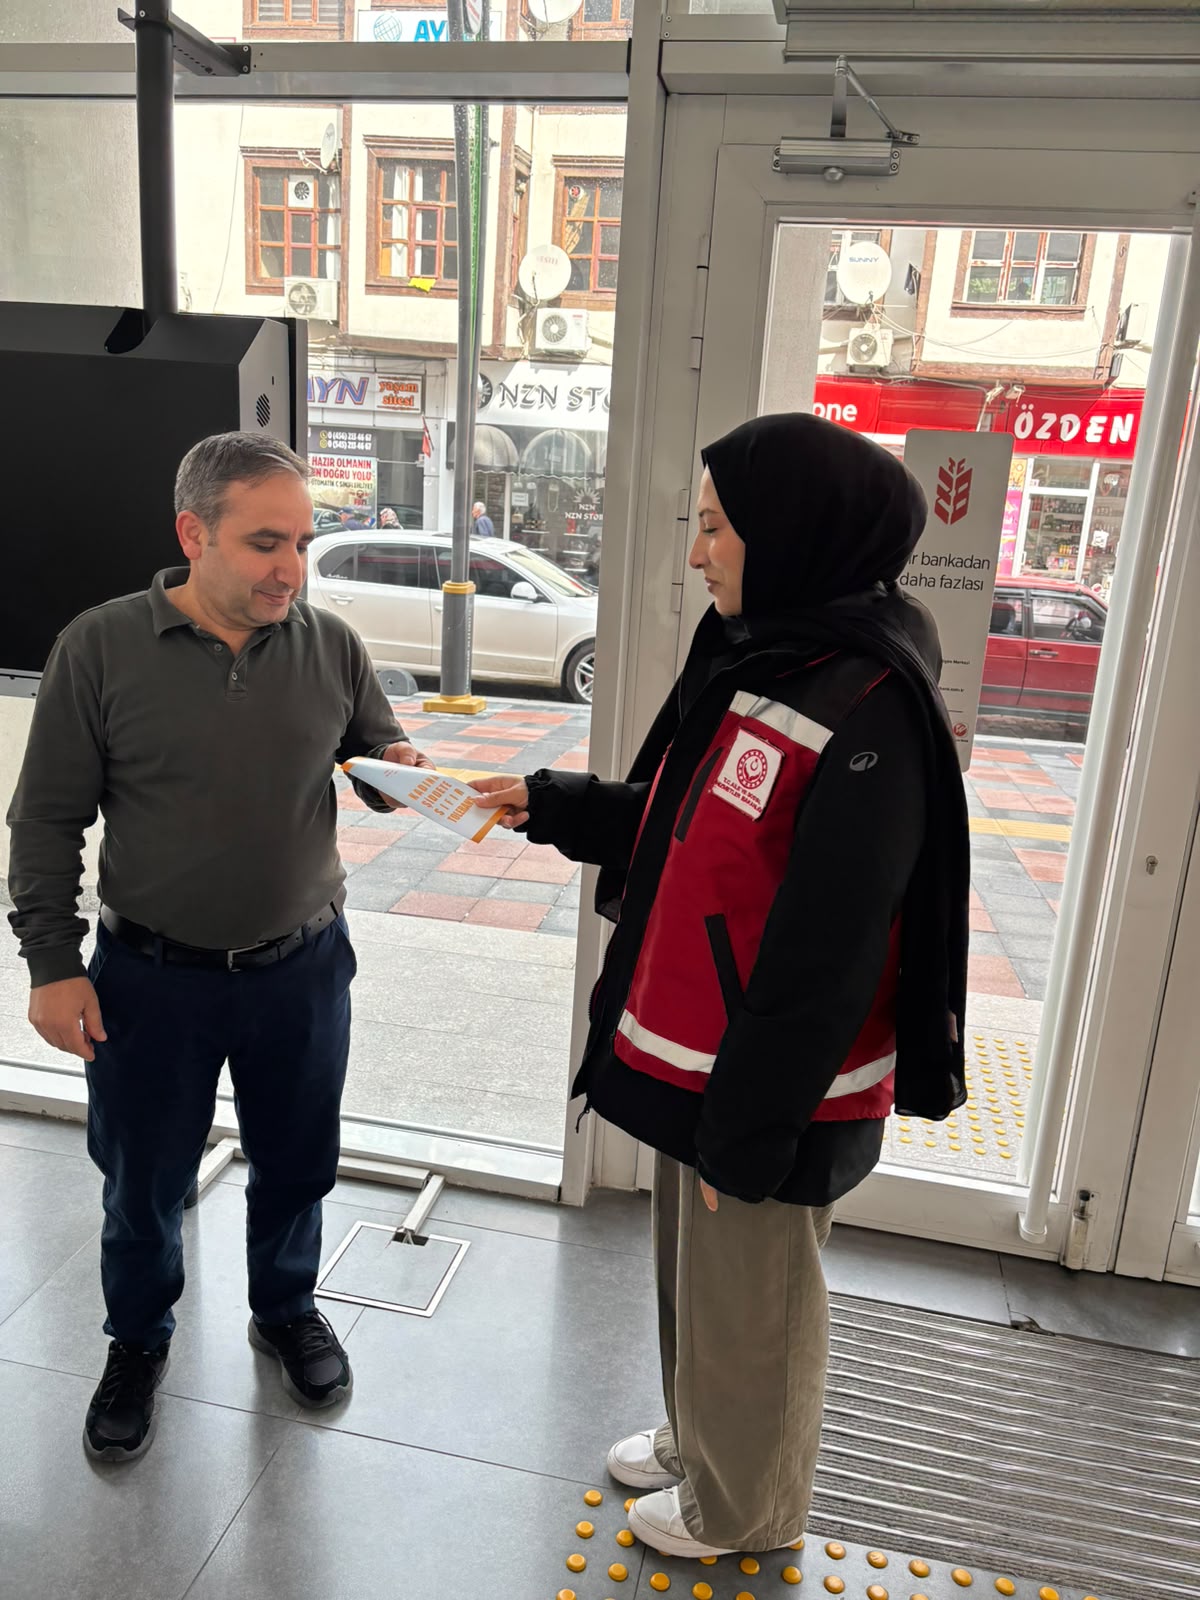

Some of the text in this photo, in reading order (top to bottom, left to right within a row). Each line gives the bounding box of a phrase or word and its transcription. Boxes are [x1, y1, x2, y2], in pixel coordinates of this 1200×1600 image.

[378, 380, 419, 394] yaşam
[499, 382, 559, 409] NZN
[382, 394, 415, 407] sitesi
[812, 402, 858, 422] one
[1013, 403, 1135, 445] ÖZDEN
[312, 456, 372, 470] HAZIR OLMANIN
[323, 467, 350, 480] DOĞRU
[352, 471, 372, 481] YOLU
[921, 552, 991, 571] bankadan
[899, 571, 985, 591] daha fazlası
[408, 775, 440, 800] KADINA
